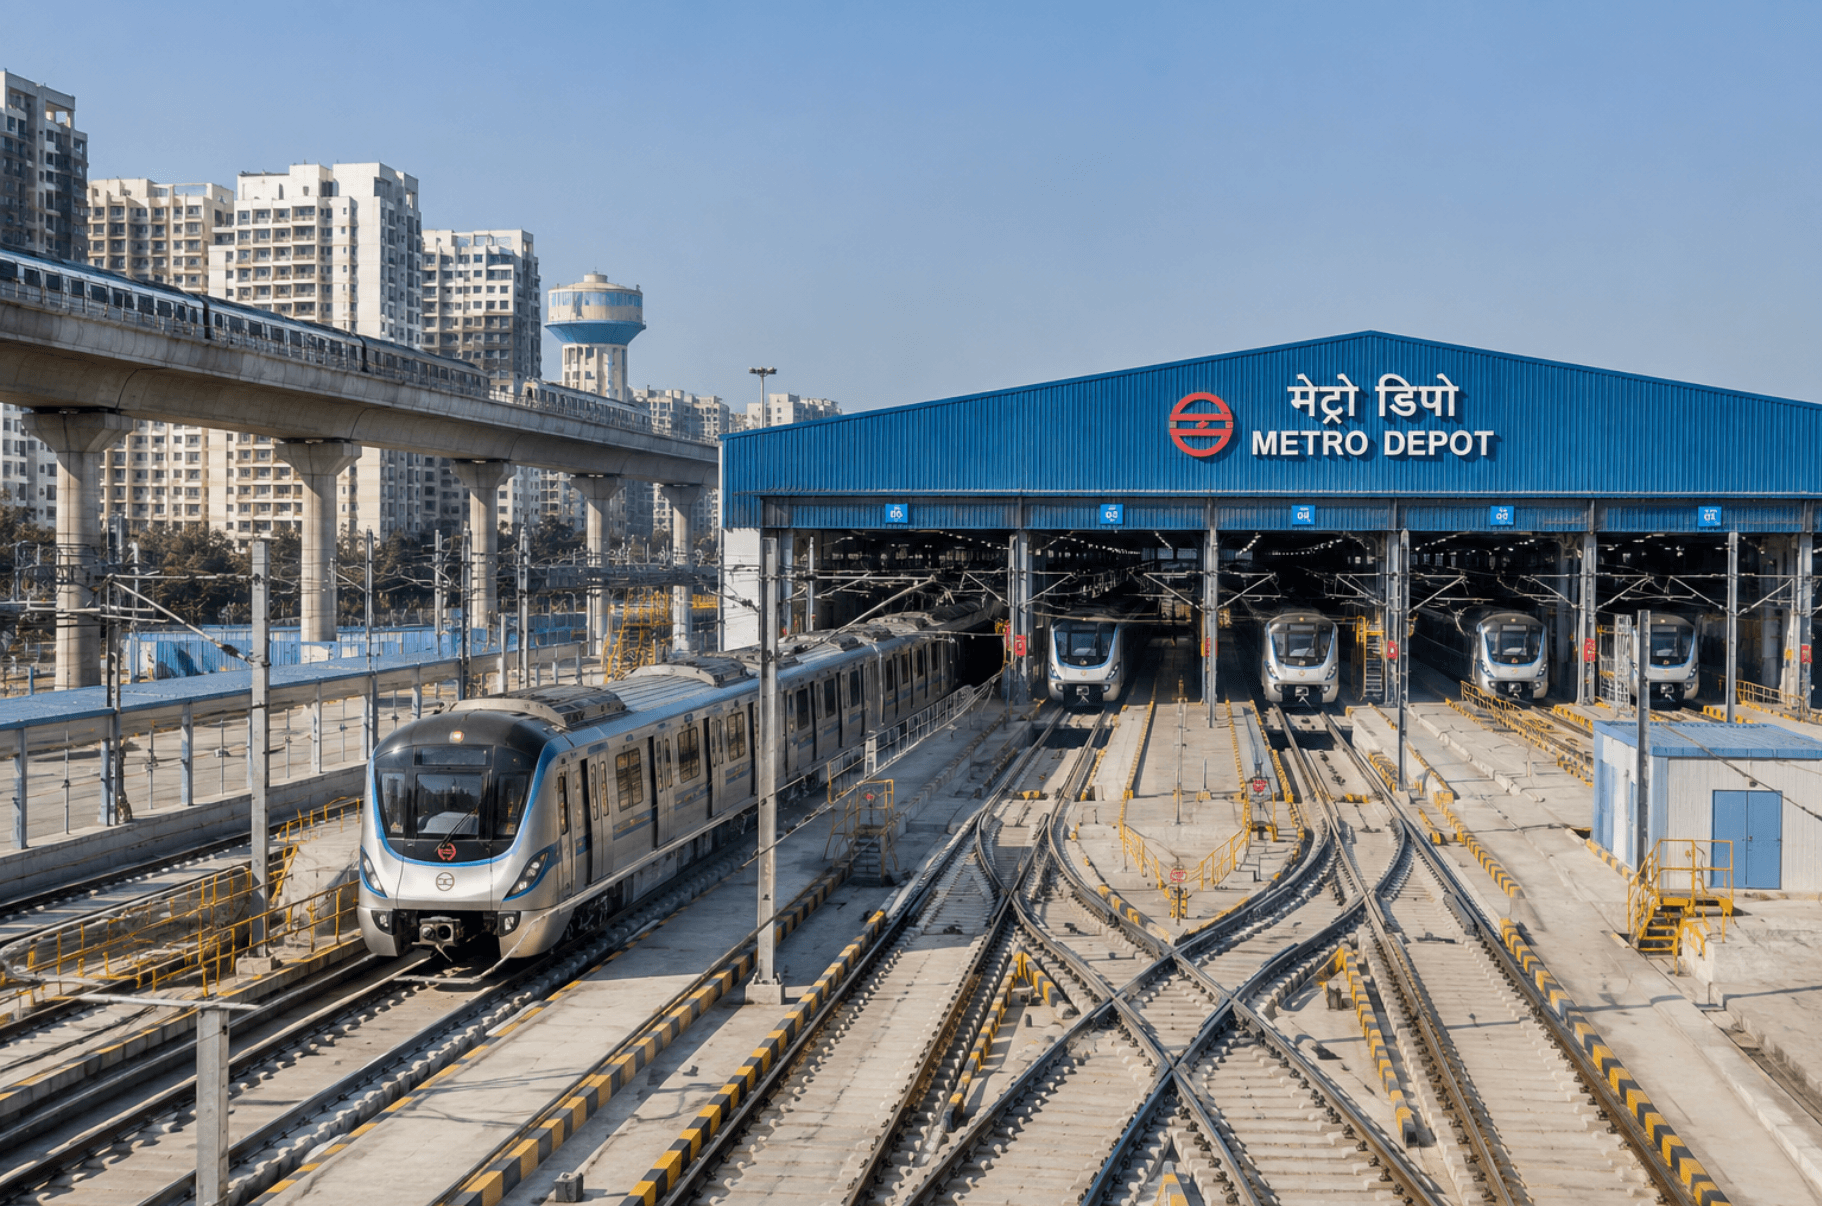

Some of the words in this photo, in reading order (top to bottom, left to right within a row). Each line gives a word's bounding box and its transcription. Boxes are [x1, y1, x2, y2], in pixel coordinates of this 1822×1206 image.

[1287, 373, 1359, 425] मेट्रो
[1375, 373, 1459, 417] डिपो
[1252, 430, 1368, 456] METRO
[1383, 430, 1494, 456] DEPOT
